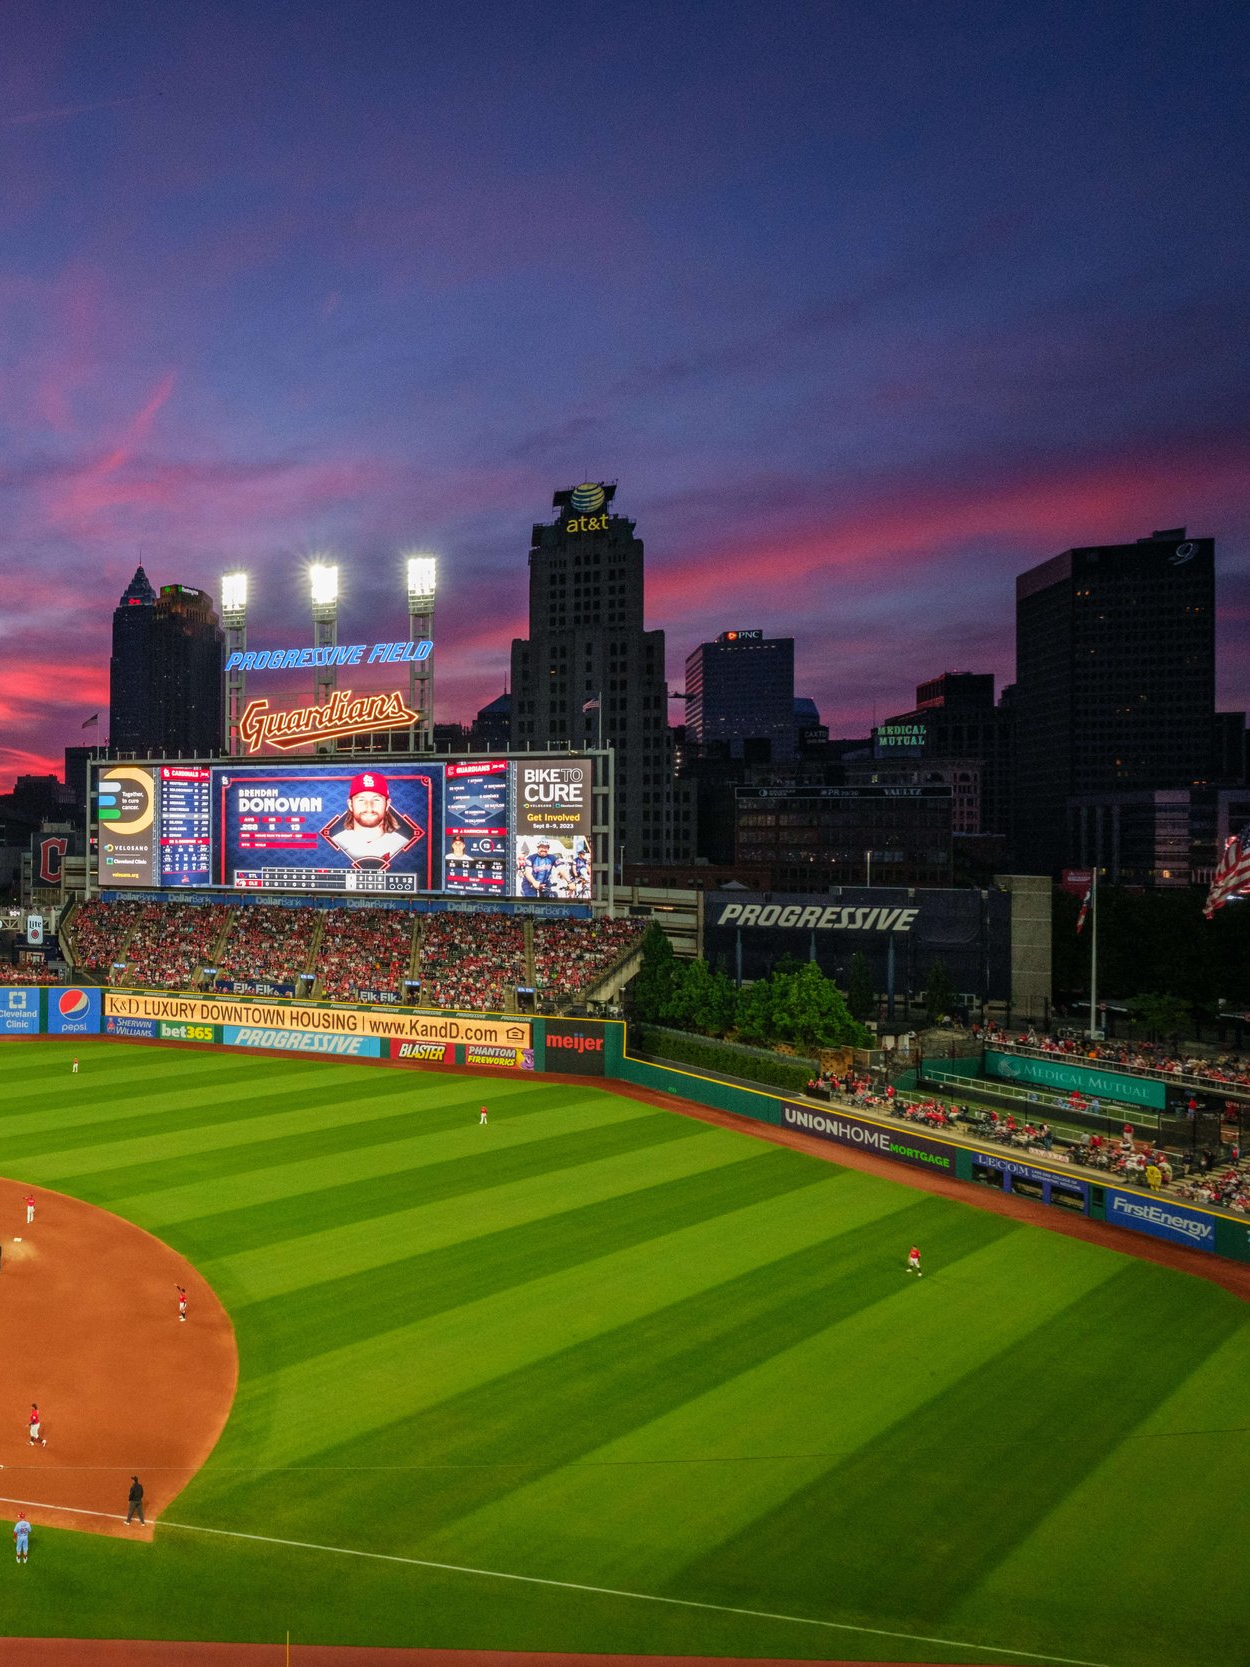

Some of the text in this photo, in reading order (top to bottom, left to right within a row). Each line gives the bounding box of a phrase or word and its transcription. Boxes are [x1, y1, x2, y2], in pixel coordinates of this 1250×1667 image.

[566, 513, 609, 533] at&t
[738, 630, 760, 639] PNC
[225, 640, 434, 671] PROGRESSIVE FIELD
[240, 690, 419, 752] Guardians
[877, 724, 926, 736] MEDICAL
[878, 736, 925, 746] MUTUAL
[524, 768, 584, 782] BIKE TO
[239, 789, 278, 797] BRENDAN
[524, 784, 583, 802] CURE
[239, 797, 322, 812] DONOVAN
[527, 814, 542, 822] Get
[28, 920, 42, 929] Lite
[717, 904, 920, 932] PROGRESSIVE
[5, 1020, 29, 1029] Clinic
[61, 1022, 87, 1033] pepsi
[109, 997, 498, 1043] K&D LUXURY DOWNTOWN HOUSING www.KandD.com
[117, 1018, 152, 1028] SHERWIN
[161, 1023, 213, 1041] bet365
[235, 1029, 363, 1055] PROGRESSIVE
[546, 1032, 604, 1053] meijer
[398, 1043, 446, 1061] BLASTER
[468, 1046, 516, 1058] PHANTOM
[467, 1055, 516, 1067] FIREWORKS
[1023, 1065, 1084, 1086] MEDICAL
[1088, 1077, 1150, 1099] MUTUAL
[889, 1142, 950, 1168] MORTGAGE
[1113, 1196, 1213, 1237] FirstEnergy
